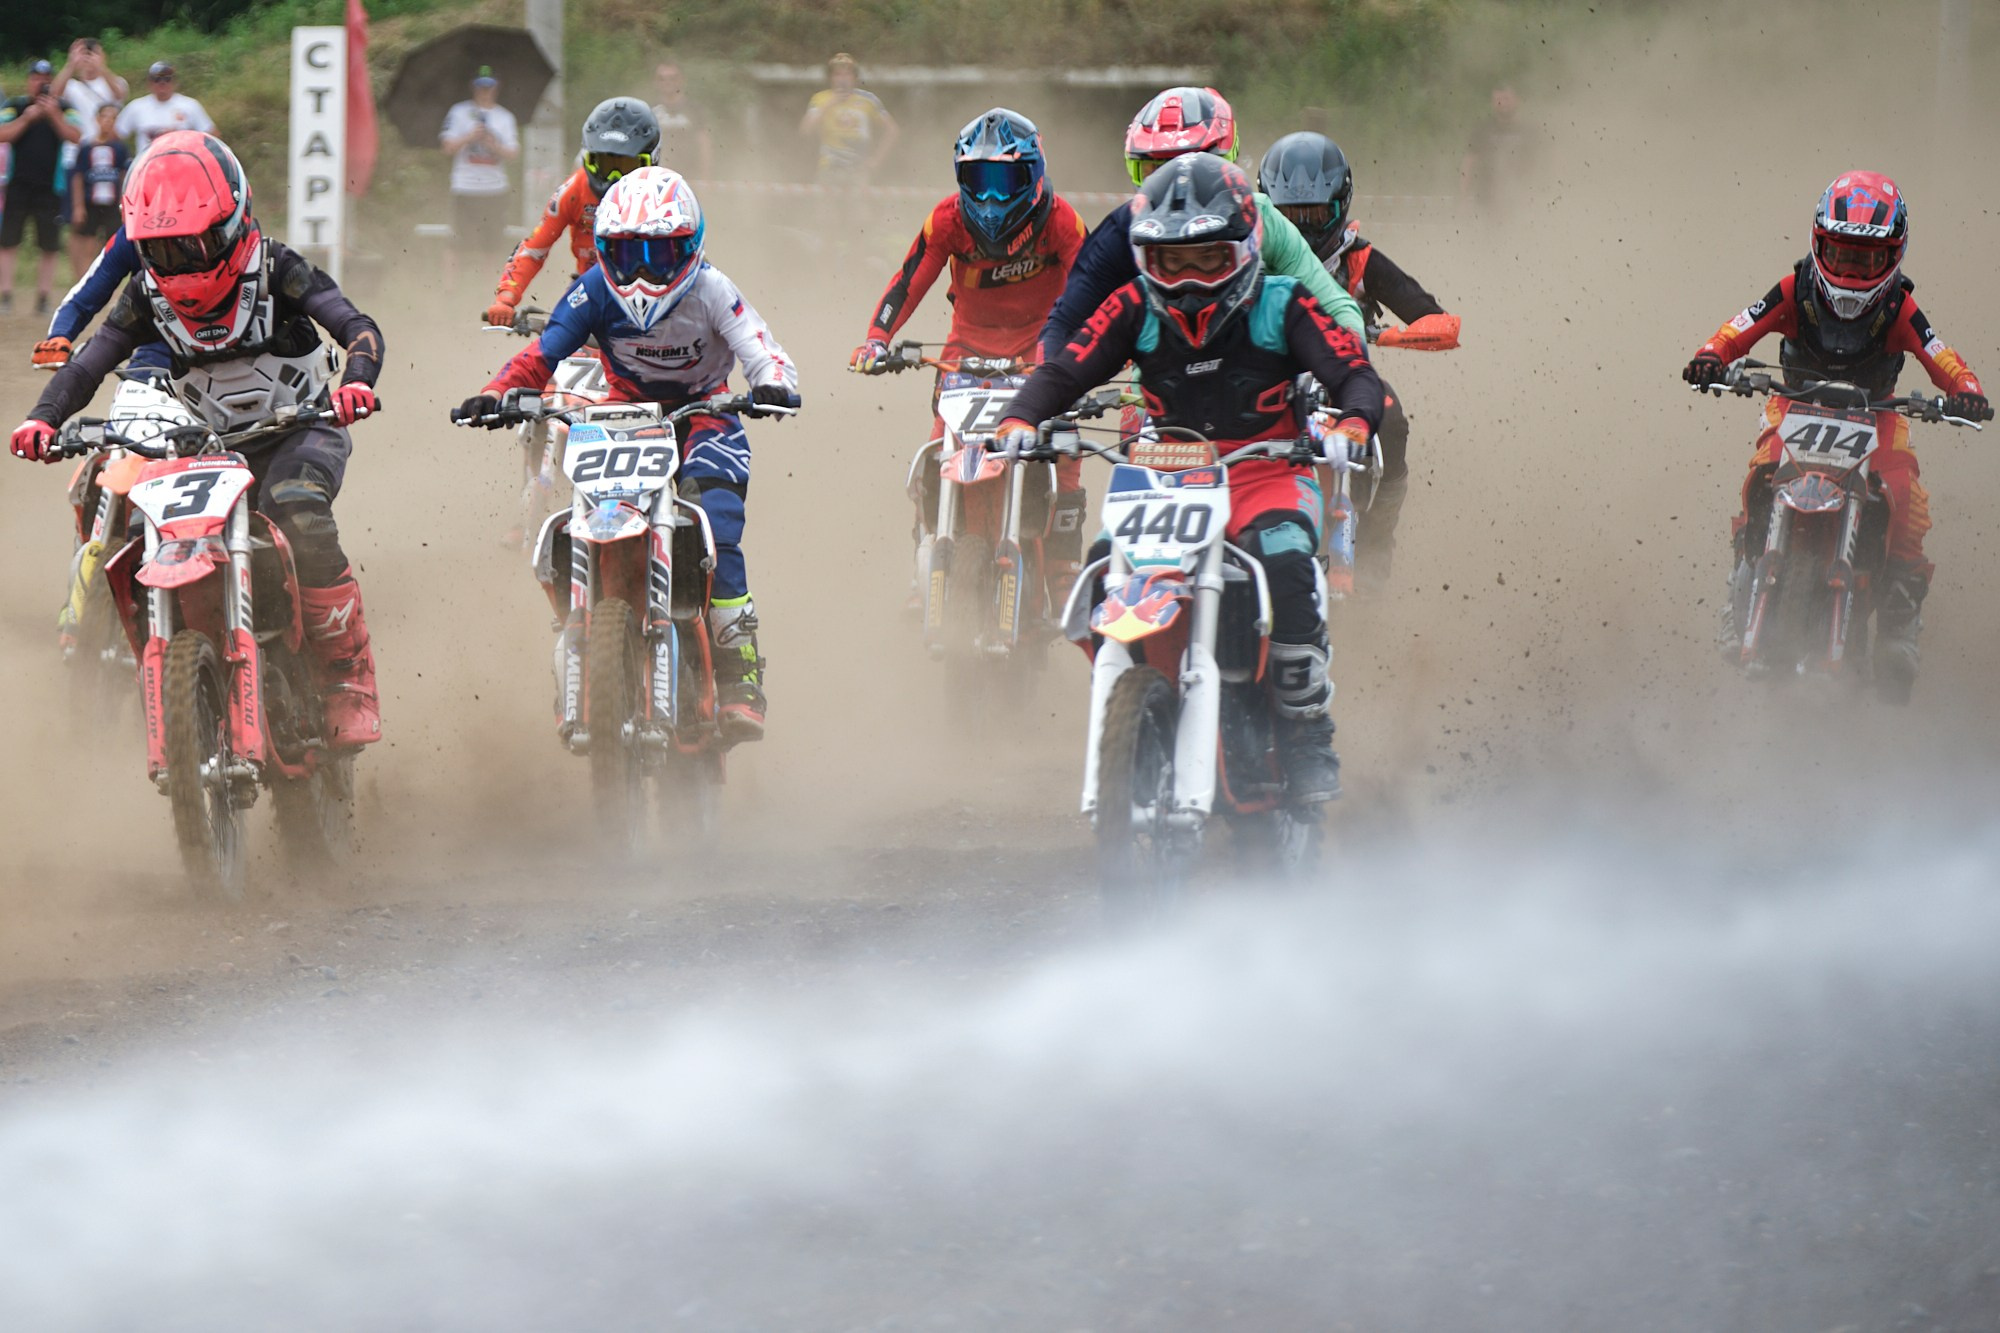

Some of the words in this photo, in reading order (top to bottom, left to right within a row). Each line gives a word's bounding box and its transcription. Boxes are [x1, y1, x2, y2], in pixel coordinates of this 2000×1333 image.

[302, 41, 333, 243] СТАРТ
[992, 260, 1034, 280] LEATT
[1133, 456, 1208, 466] RENTHAL
[1134, 445, 1208, 453] RENTHAL
[1784, 423, 1873, 460] 414
[572, 446, 674, 483] 203
[162, 471, 225, 520] 3
[1115, 503, 1213, 544] 440
[565, 648, 581, 721] Mitas
[653, 642, 671, 718] Mitas
[146, 667, 158, 739] DUNLOP
